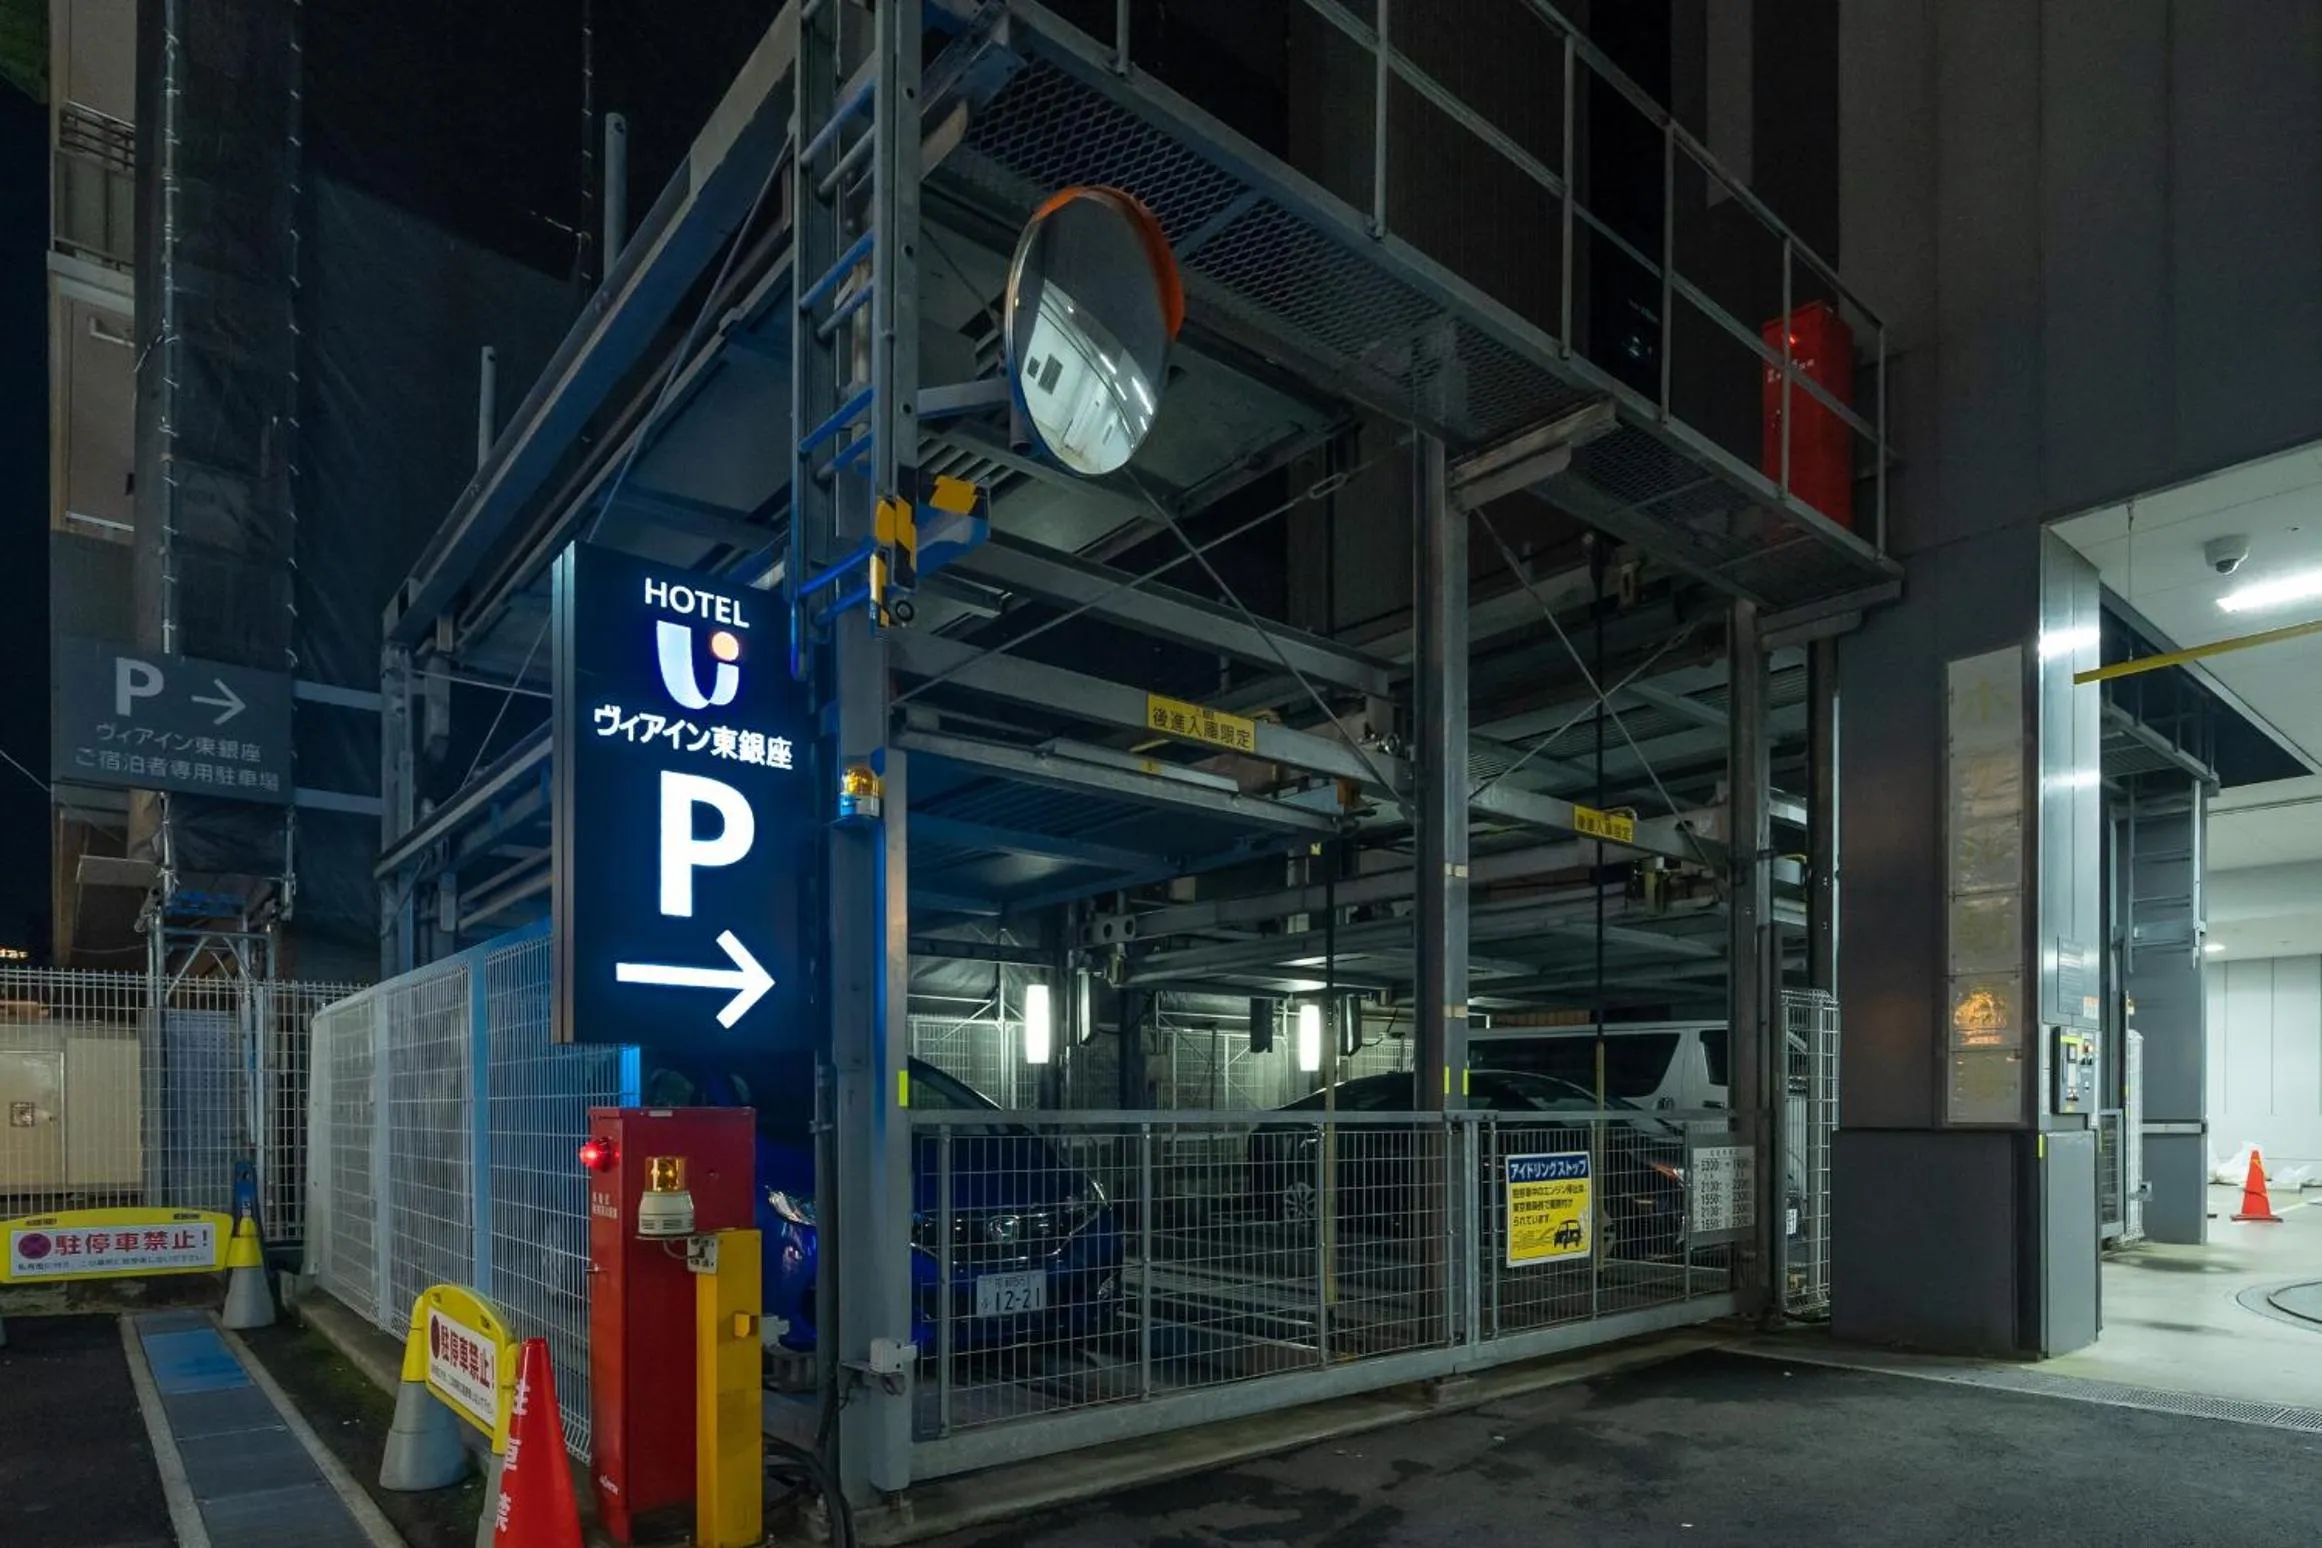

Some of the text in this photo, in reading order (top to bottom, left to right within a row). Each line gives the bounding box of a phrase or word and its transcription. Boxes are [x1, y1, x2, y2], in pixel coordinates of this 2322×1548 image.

[644, 577, 750, 629] HOTEL
[115, 656, 164, 717] P
[96, 721, 261, 763] ヴィアイン東銀座
[593, 704, 793, 770] ヴィアイン東銀座
[75, 747, 280, 792] ご宿泊者専用駐車場
[660, 769, 756, 918] P
[1510, 1160, 1587, 1180] アイドリングストップ
